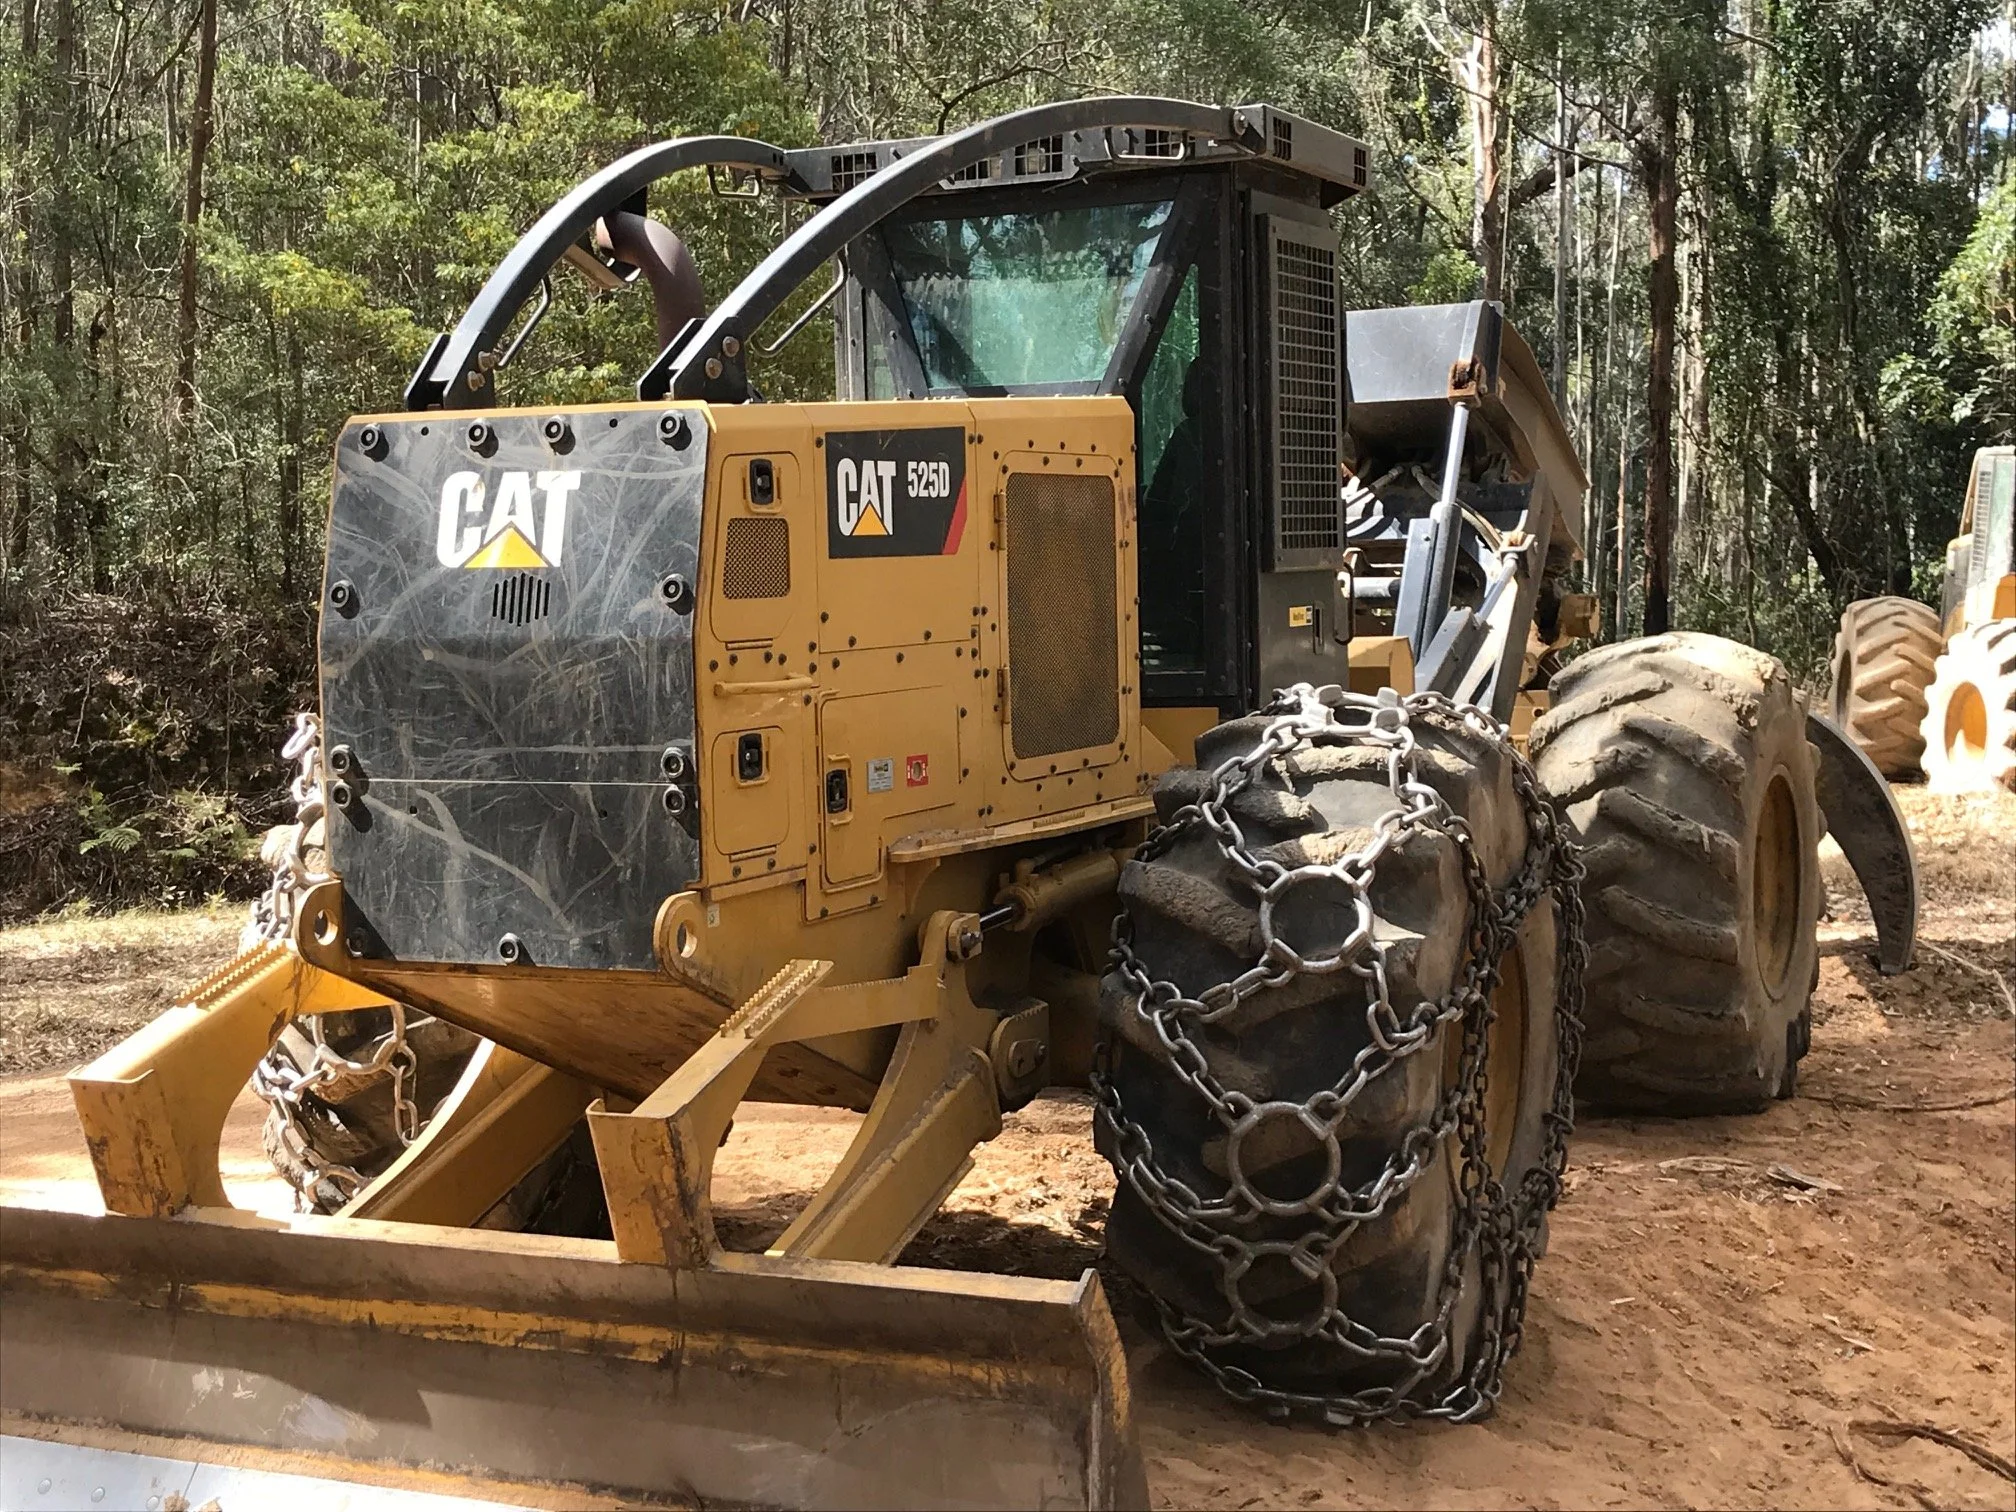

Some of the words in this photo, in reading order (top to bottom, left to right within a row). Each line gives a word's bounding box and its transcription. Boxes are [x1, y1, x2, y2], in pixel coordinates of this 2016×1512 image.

[436, 470, 582, 568] CAT
[837, 457, 897, 536] CAT
[907, 460, 950, 498] 525D
